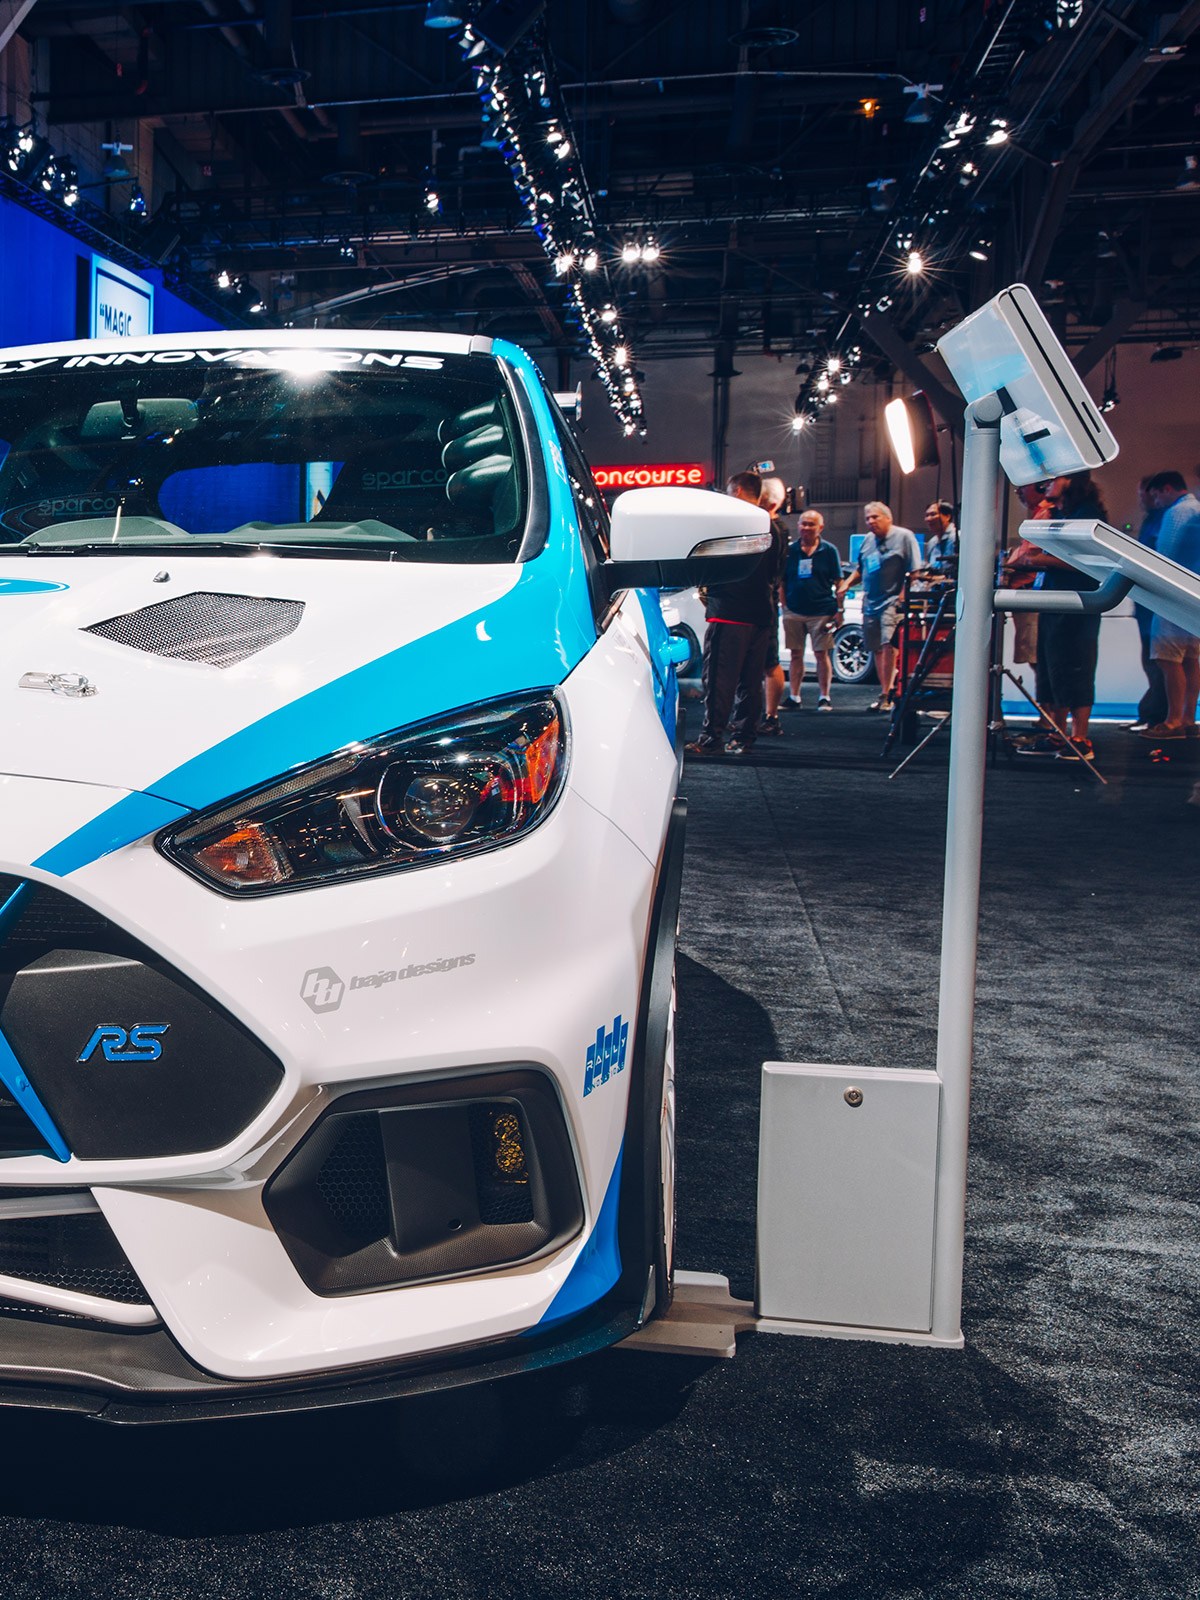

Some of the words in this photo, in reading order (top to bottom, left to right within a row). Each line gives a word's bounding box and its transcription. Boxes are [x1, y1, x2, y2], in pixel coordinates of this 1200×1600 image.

[63, 349, 445, 371] INNOVAONS
[362, 468, 448, 492] sparco
[594, 469, 702, 486] oncourse
[39, 498, 117, 517] sparco
[349, 970, 397, 991] baja
[398, 953, 476, 980] designs
[76, 1022, 171, 1062] RS
[586, 1037, 626, 1072] RALLY
